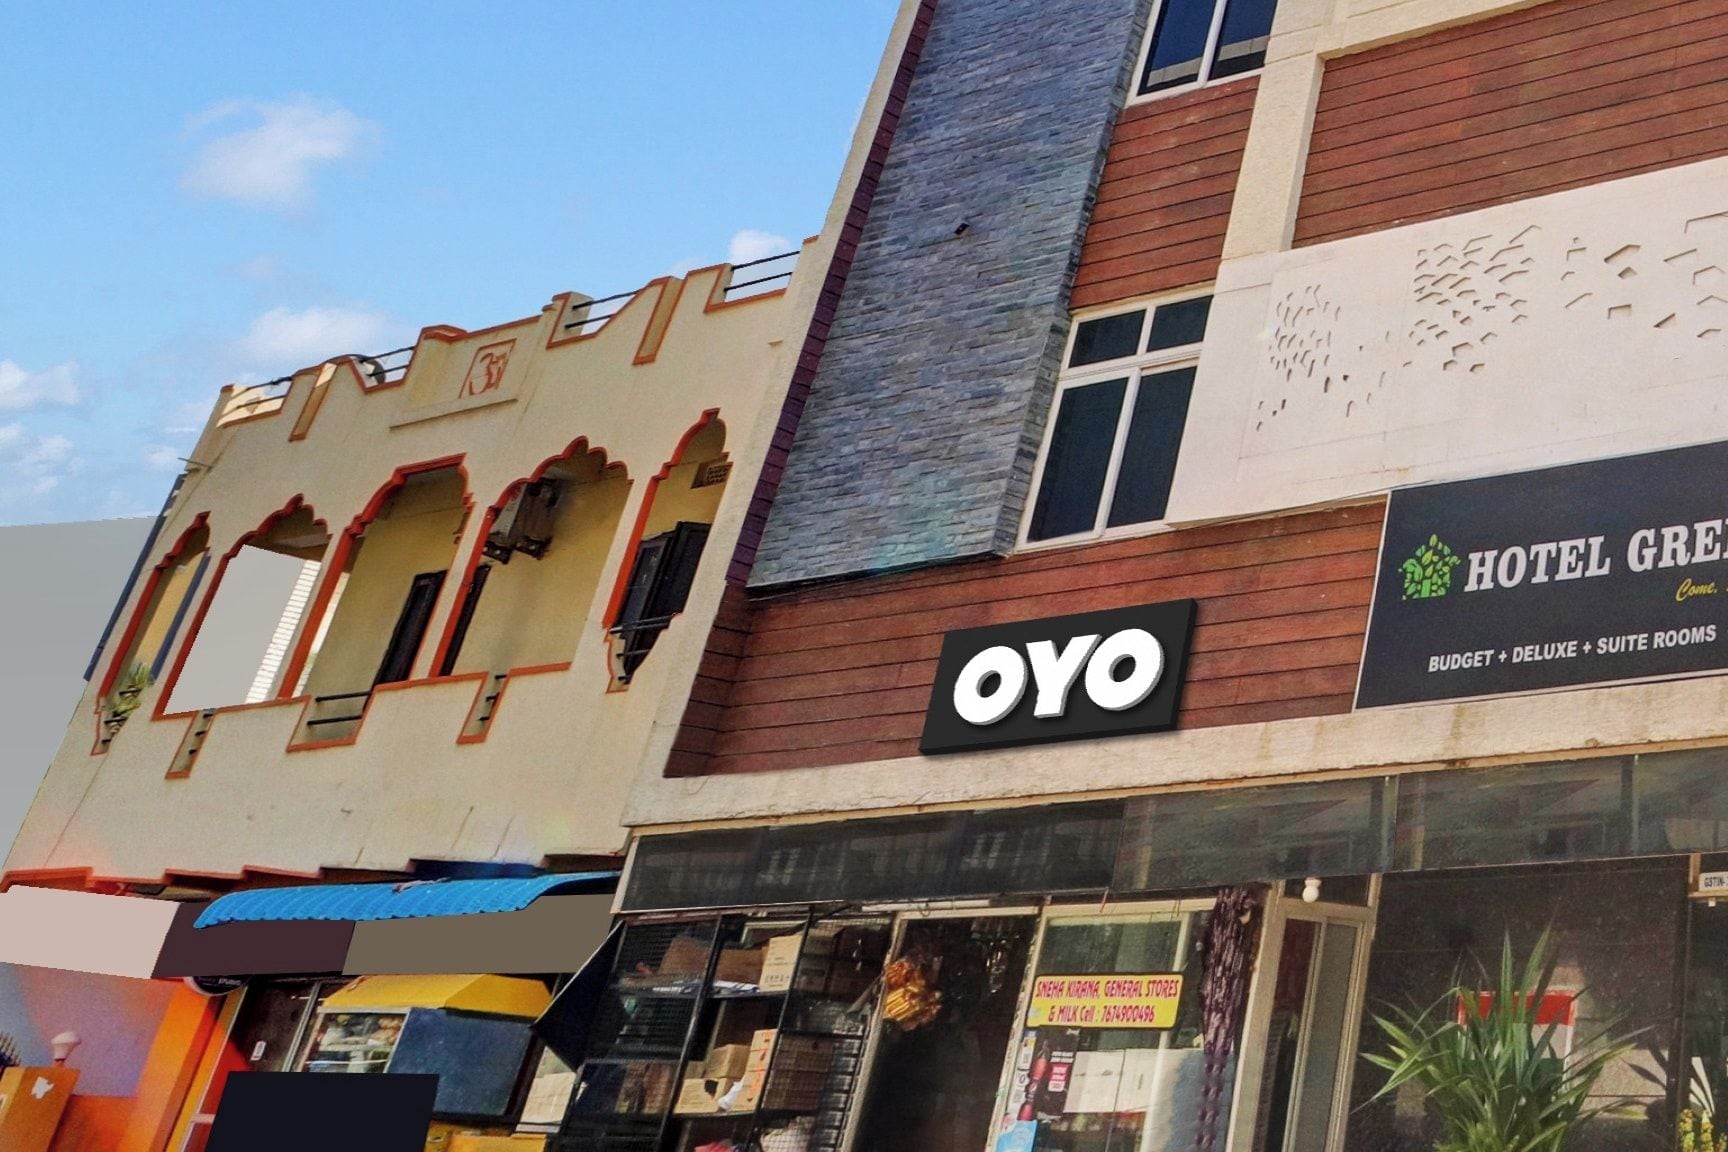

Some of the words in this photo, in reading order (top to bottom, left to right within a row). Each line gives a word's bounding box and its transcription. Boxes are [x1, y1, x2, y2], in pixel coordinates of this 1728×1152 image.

[1464, 535, 1611, 592] HOTEL
[1428, 649, 1494, 672] BUDGET
[1511, 640, 1578, 664] DELUXE
[1596, 633, 1649, 655] SUITE
[1653, 624, 1717, 649] ROOMS
[953, 628, 1165, 726] OYO
[1036, 980, 1065, 998] SNEHA
[1104, 979, 1142, 997] GENERAL
[1145, 979, 1180, 998] STORES
[1058, 1005, 1079, 1022] MILK
